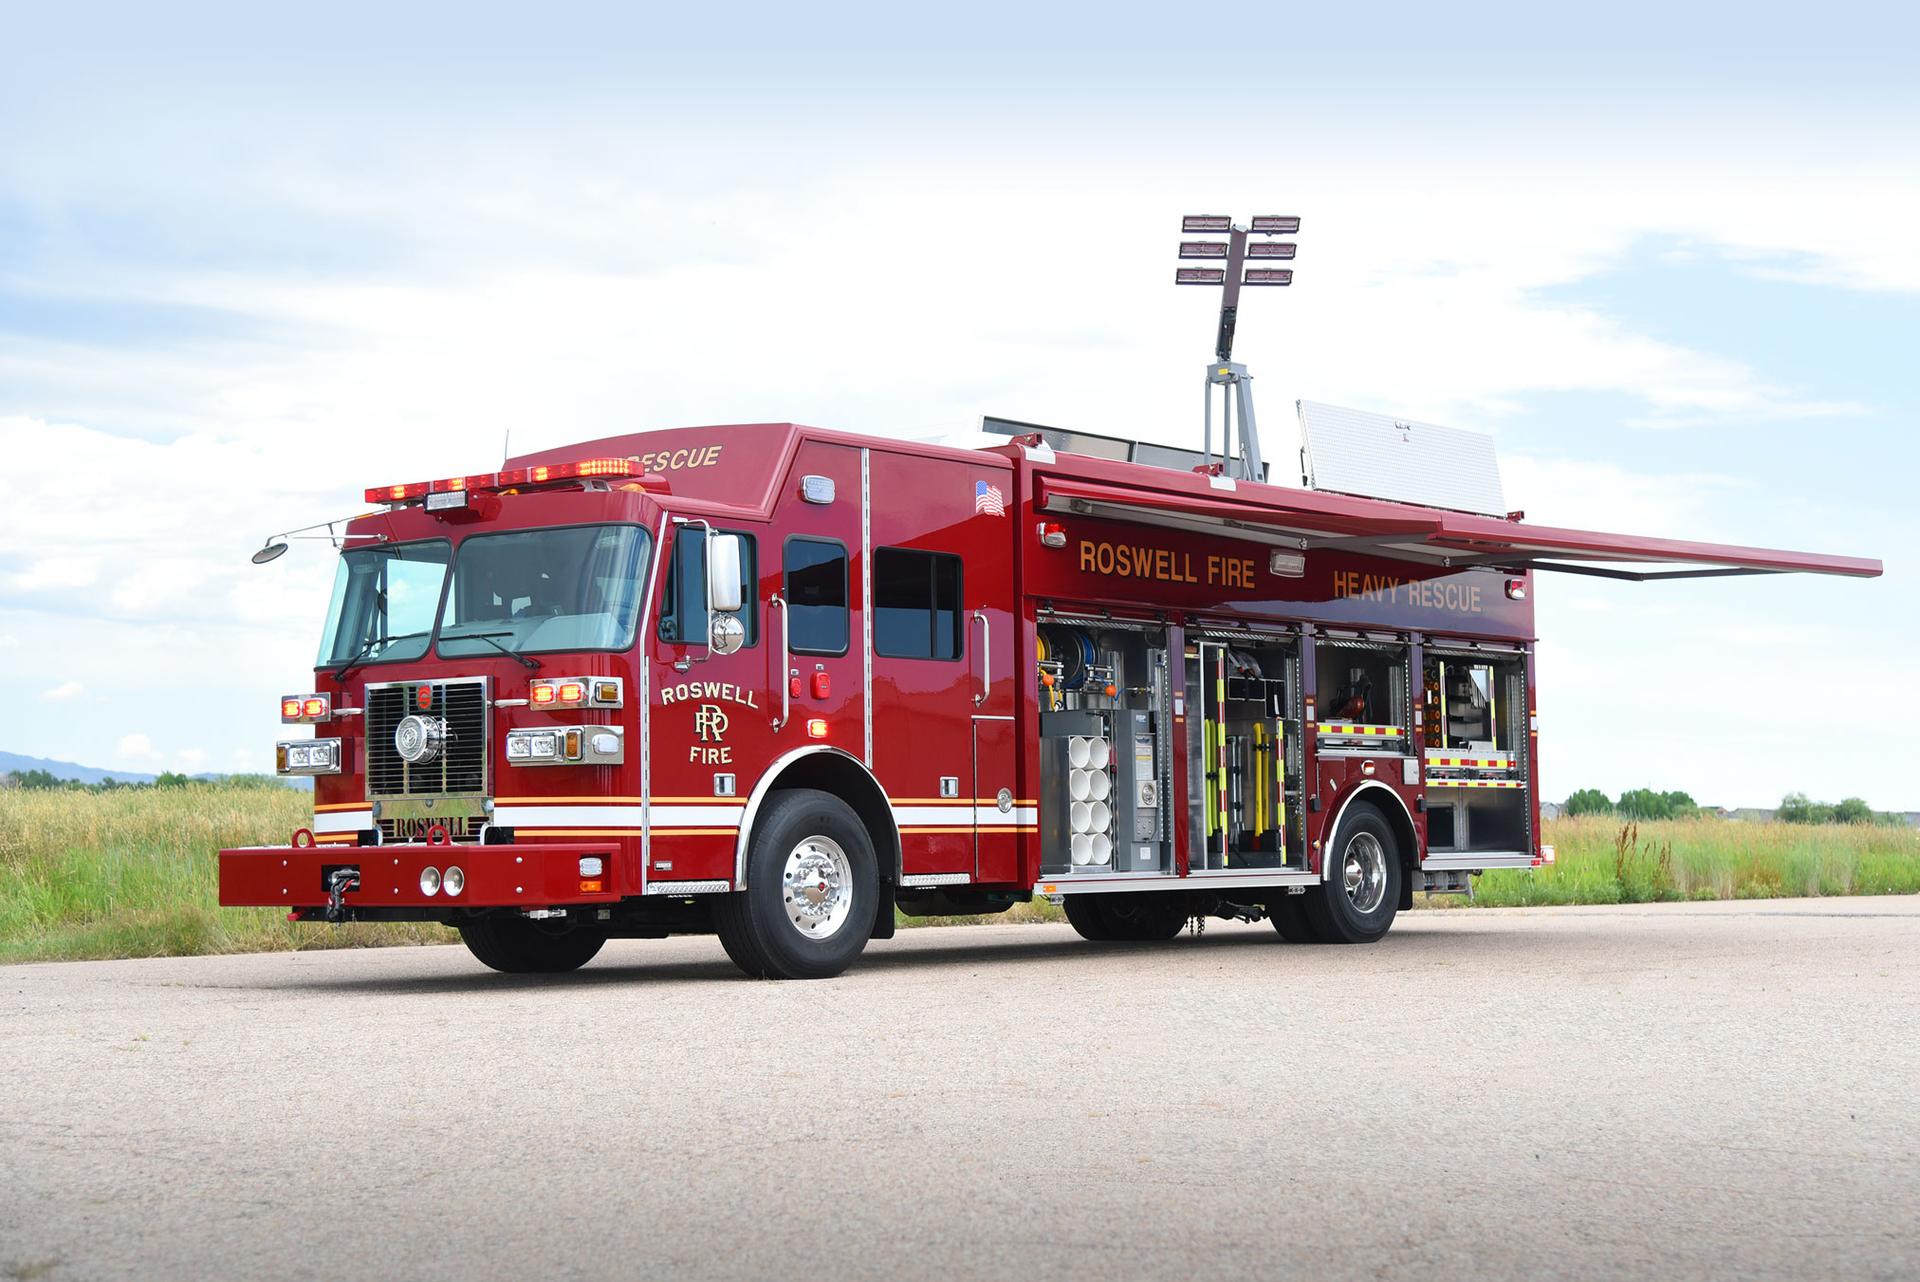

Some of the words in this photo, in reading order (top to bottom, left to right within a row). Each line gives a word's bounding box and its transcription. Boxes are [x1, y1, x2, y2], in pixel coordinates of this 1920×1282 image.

[627, 444, 723, 473] ESCUE
[1080, 540, 1198, 584] ROSWELL
[1207, 555, 1256, 589] FIRE
[1333, 570, 1400, 604] HEAVY
[1408, 579, 1482, 613] RESCUE
[660, 681, 759, 709] ROSWELL
[689, 746, 733, 765] FIRE
